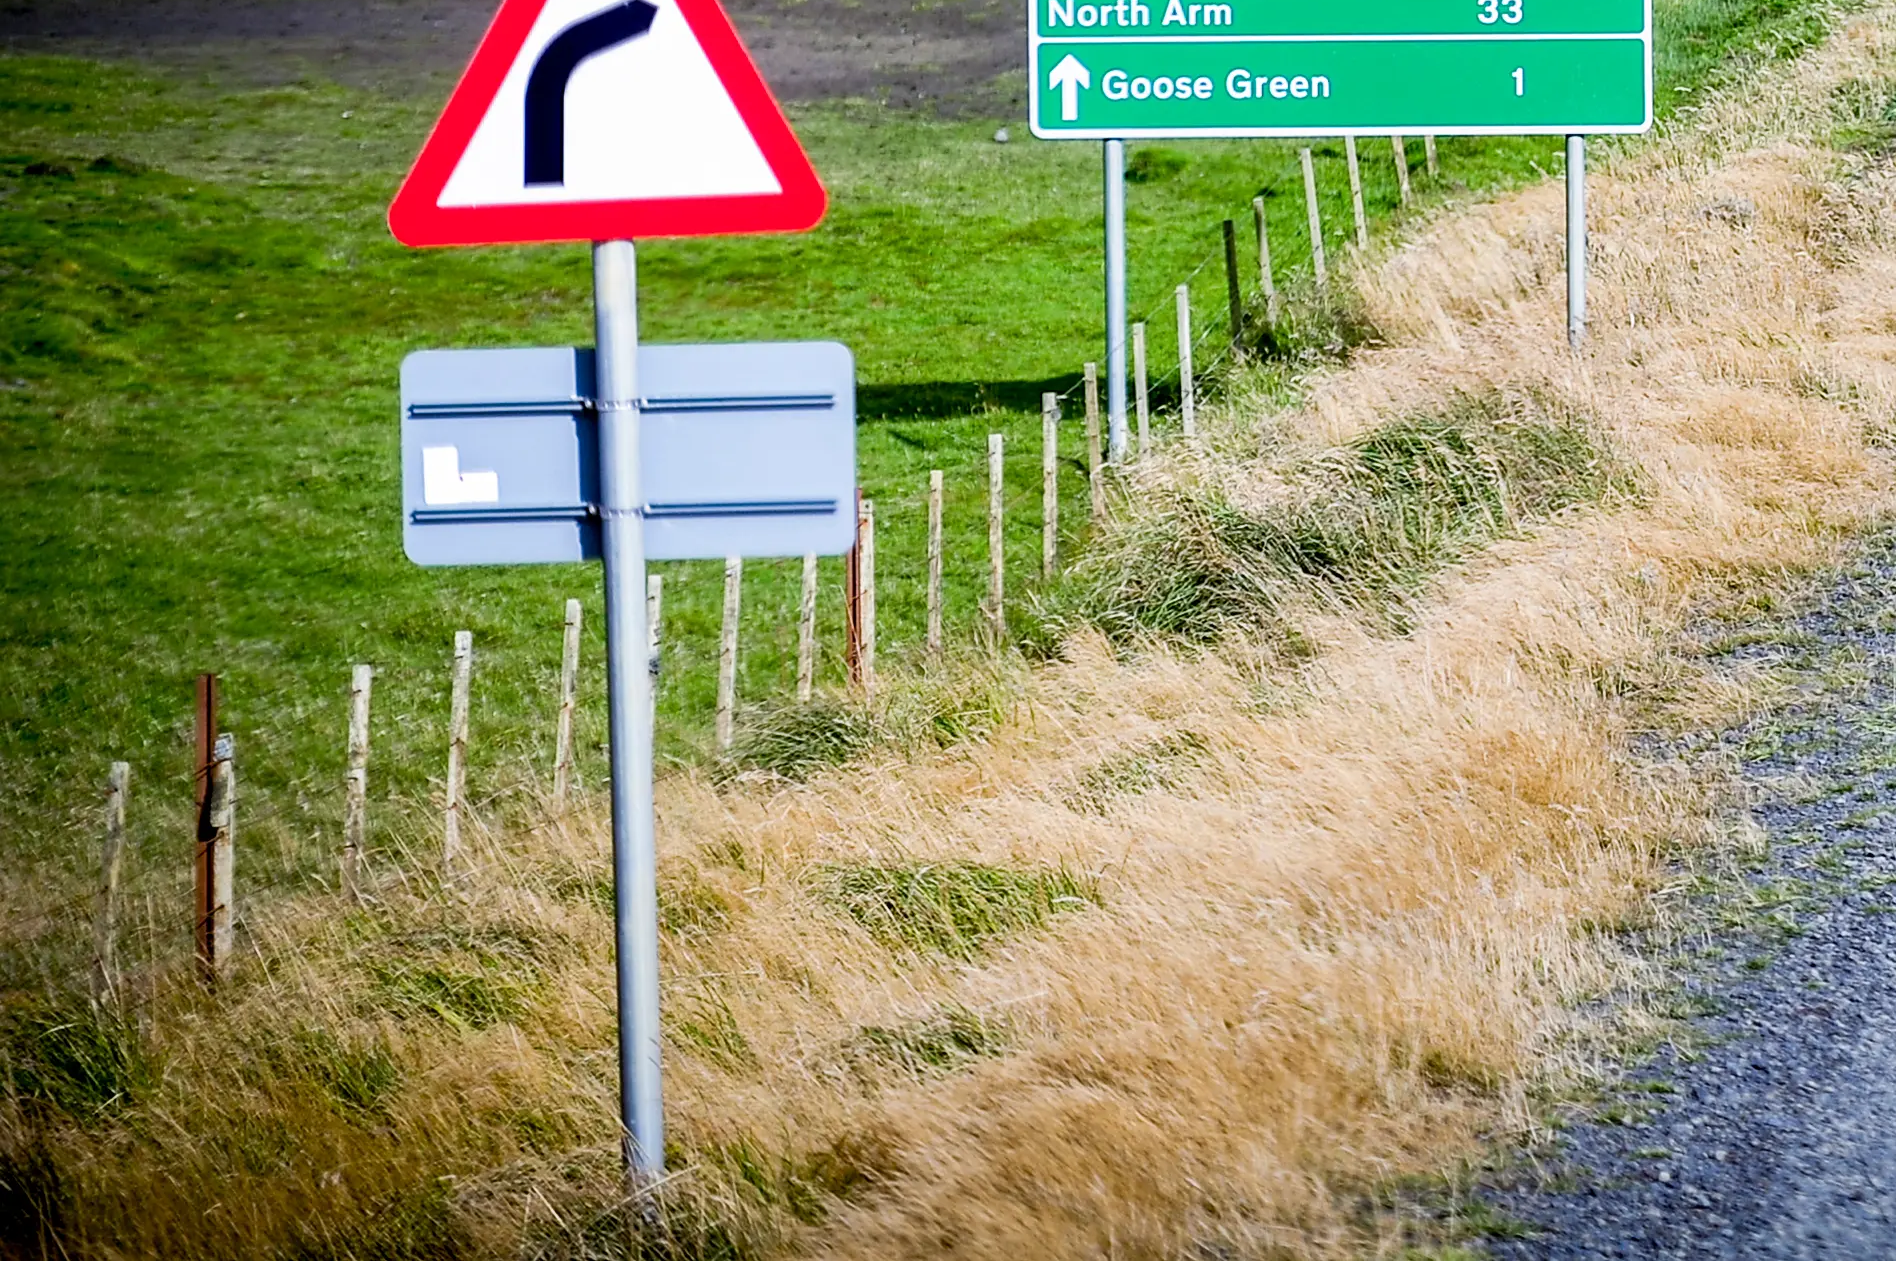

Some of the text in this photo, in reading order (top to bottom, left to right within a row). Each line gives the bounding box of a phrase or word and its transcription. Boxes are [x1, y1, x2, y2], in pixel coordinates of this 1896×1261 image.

[1102, 67, 1524, 100] Goose Green 1
